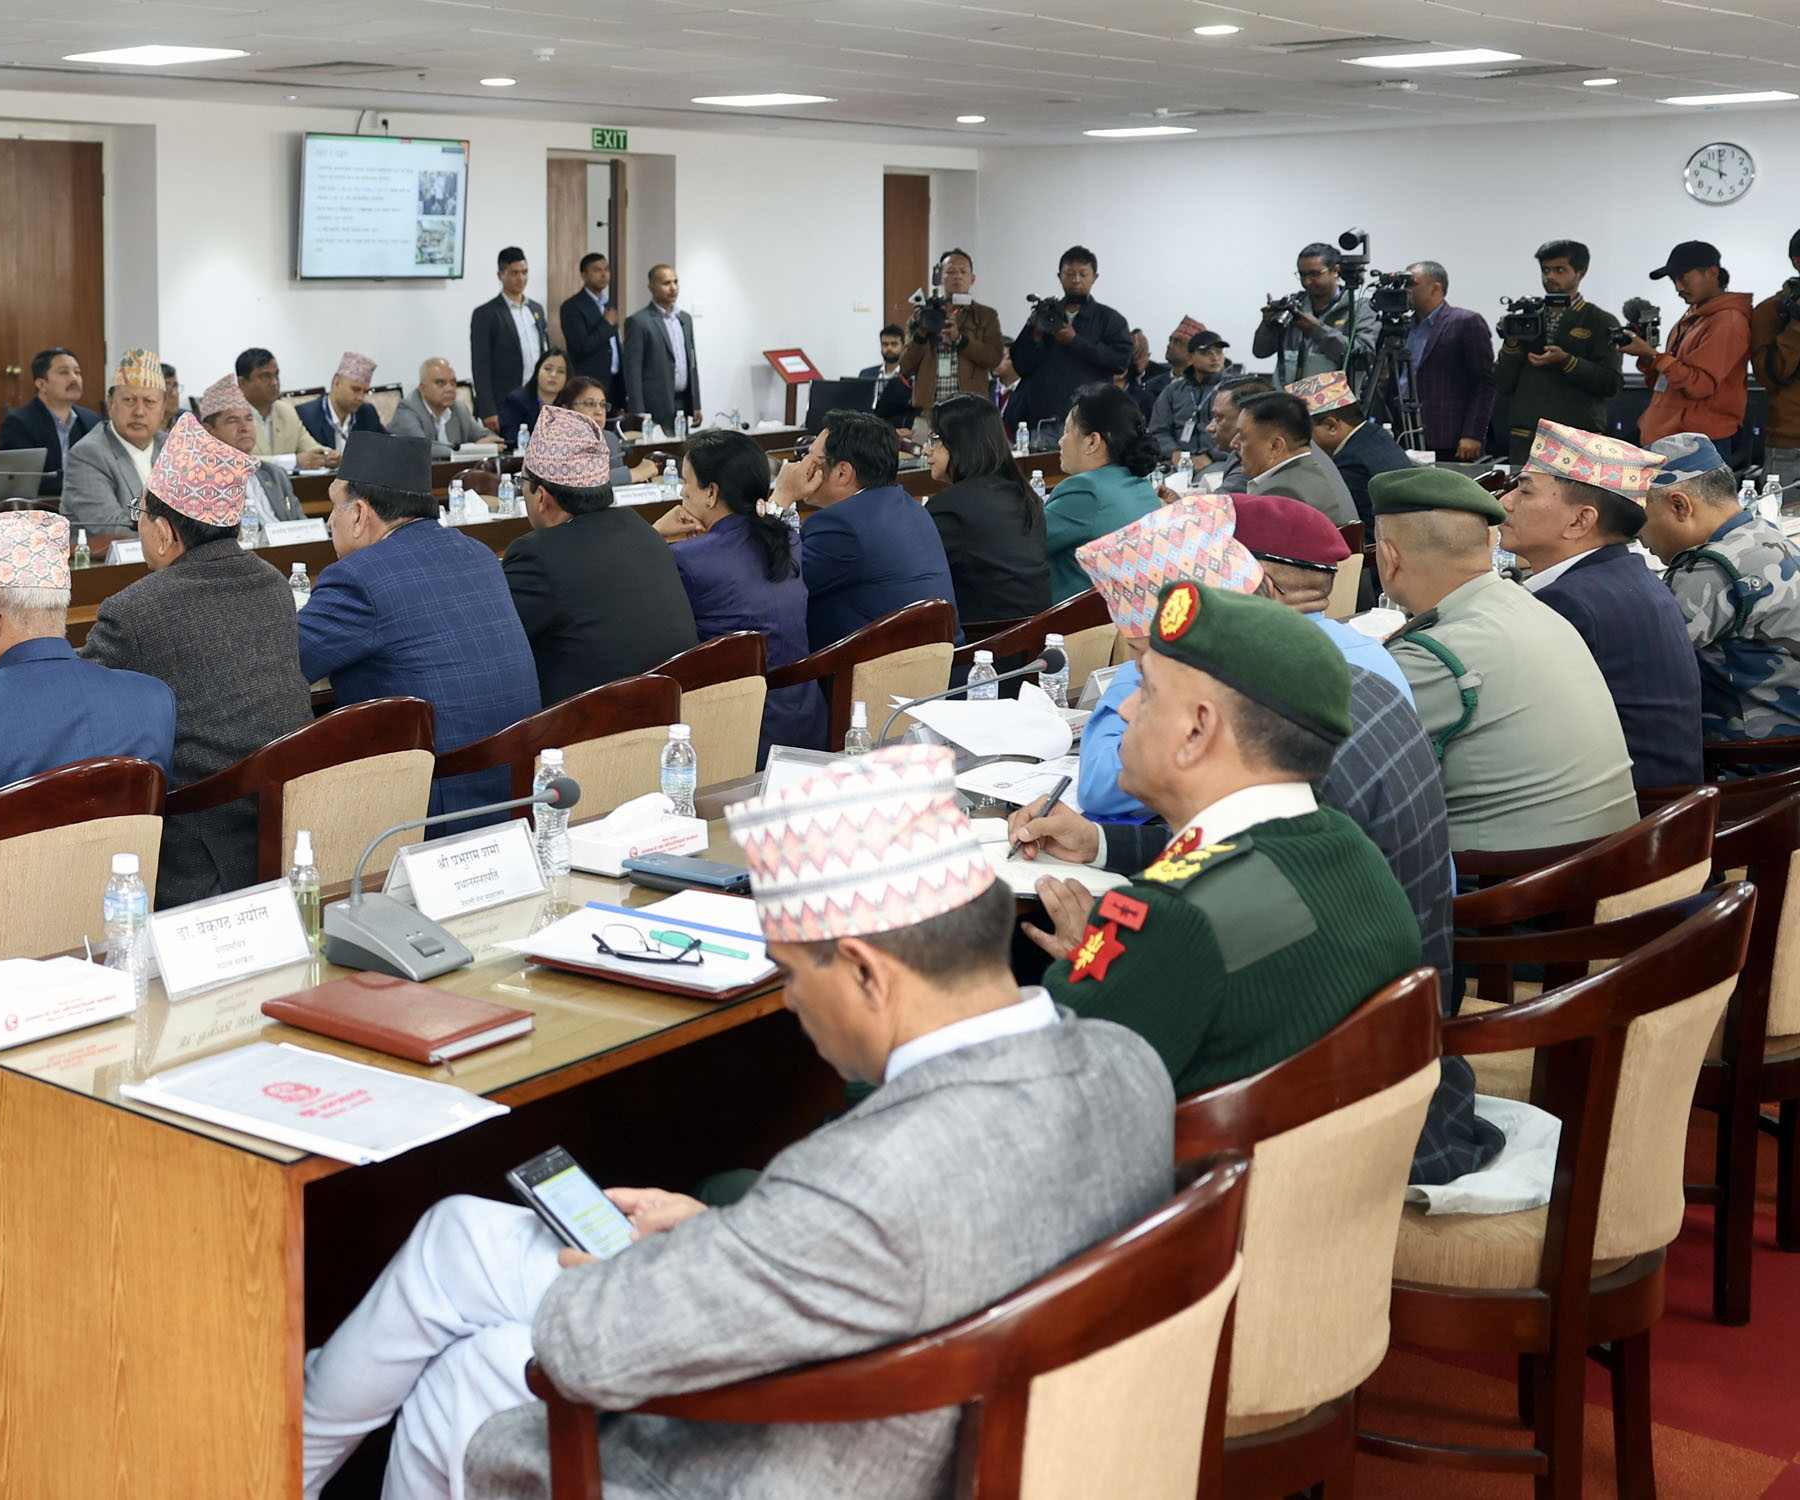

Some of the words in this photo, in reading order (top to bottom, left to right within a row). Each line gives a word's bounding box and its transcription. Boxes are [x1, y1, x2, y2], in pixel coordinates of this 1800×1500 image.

[594, 130, 626, 148] EXIT
[1707, 152, 1716, 161] 11
[1694, 169, 1700, 177] 9
[1743, 167, 1749, 176] 3
[1698, 180, 1704, 189] 8
[1707, 186, 1713, 195] 7
[1718, 188, 1724, 197] 6
[1730, 186, 1735, 194] 5
[437, 853, 449, 871] श्री
[449, 848, 480, 870] प्रभुराम
[480, 839, 501, 859] शर्मा
[454, 868, 500, 891] प्रधानसेनापति
[176, 925, 195, 942] डा.
[234, 903, 270, 927] अर्याल
